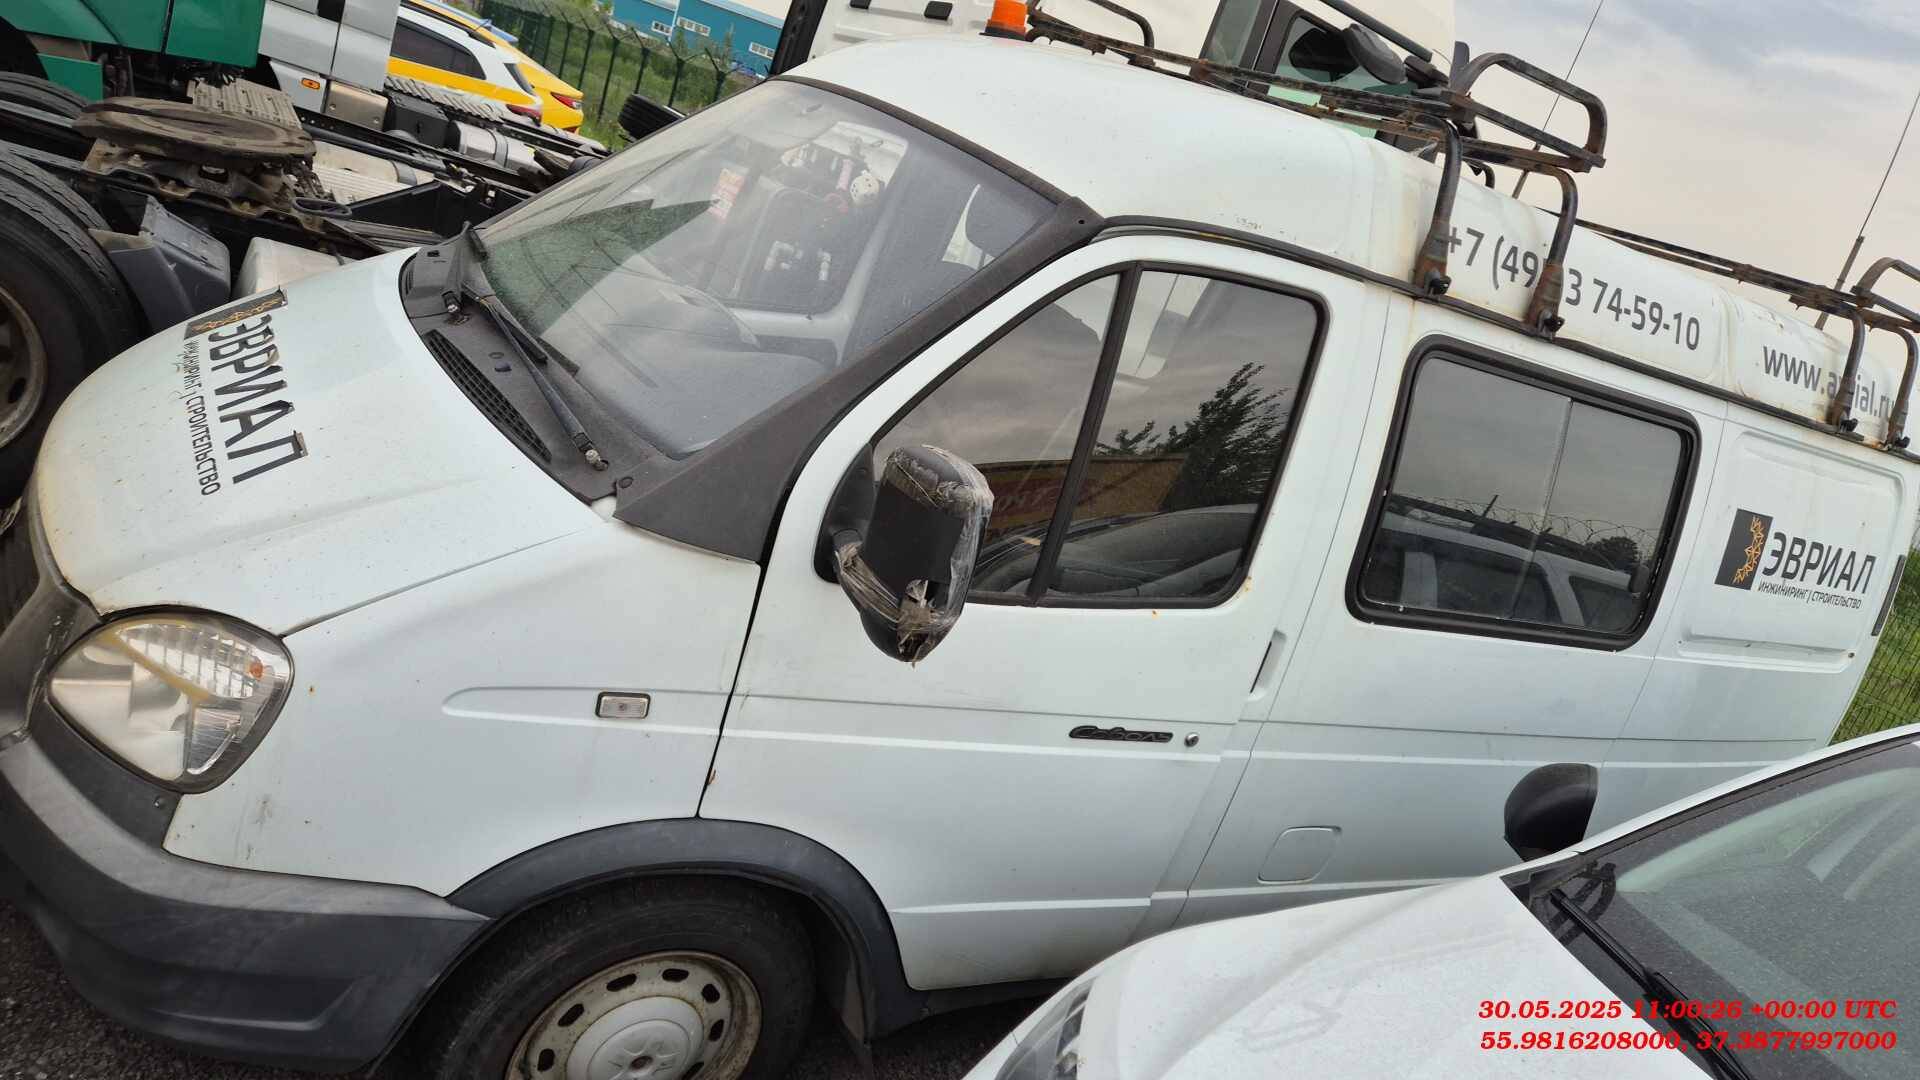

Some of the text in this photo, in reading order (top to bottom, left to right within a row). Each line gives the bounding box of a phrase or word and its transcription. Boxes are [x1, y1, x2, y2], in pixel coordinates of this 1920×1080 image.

[1592, 278, 1700, 350] 74-59-10
[208, 313, 308, 484] ЭВРИАЛ
[185, 395, 221, 496] СТРОИТЕЛЬСТВО
[1758, 580, 1862, 609] ИНЖИНИРИНГ СТРОИТЕЛЬСТВО
[1762, 532, 1877, 594] ЭВРИАЛ
